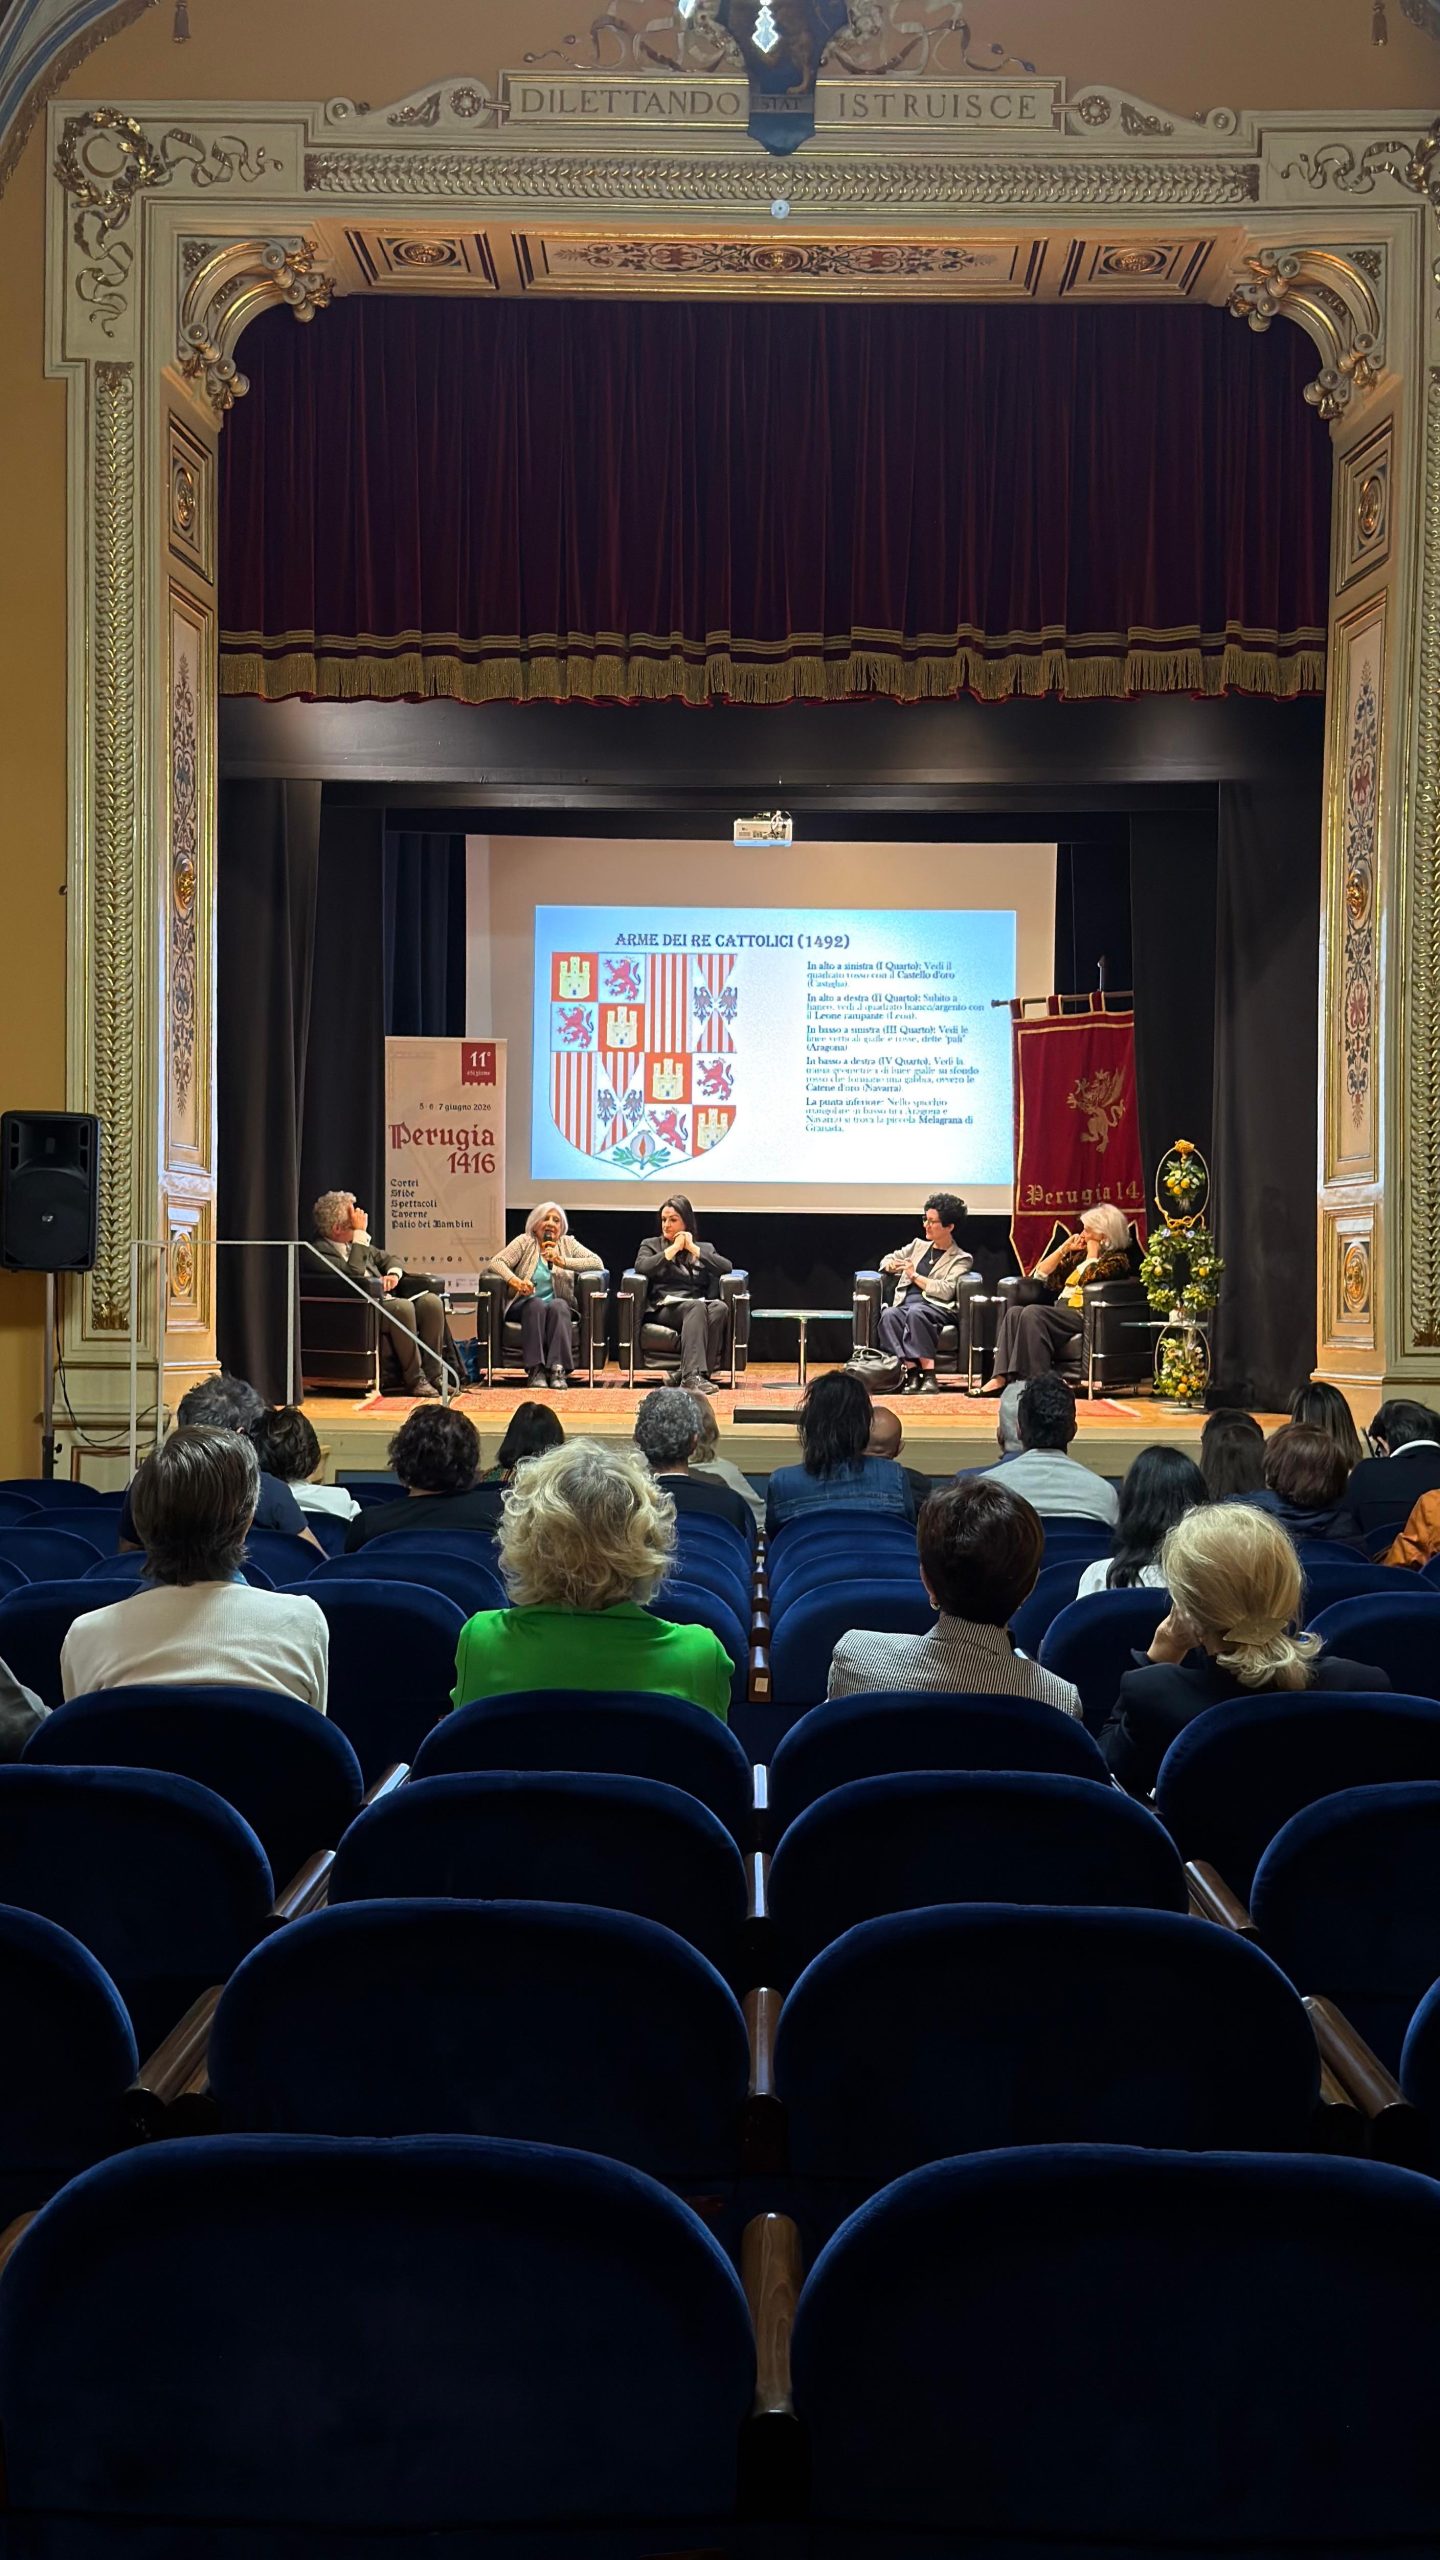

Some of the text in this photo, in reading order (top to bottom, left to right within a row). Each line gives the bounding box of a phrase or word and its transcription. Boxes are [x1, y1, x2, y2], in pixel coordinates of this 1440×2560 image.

[520, 88, 741, 116] DILETTANDO
[838, 93, 1037, 120] ISTRUISCE
[615, 933, 851, 949] ARME DEI RE CATTOLICI (1492)
[806, 961, 816, 971] In
[818, 961, 835, 971] alto
[844, 961, 874, 970] sinistra
[924, 961, 944, 970] Vedi
[897, 971, 931, 979] Castello
[807, 993, 816, 1002] In
[818, 993, 835, 1002] alto
[844, 994, 869, 1002] destra
[923, 994, 951, 1002] Subito
[806, 1025, 816, 1034] In
[817, 1025, 841, 1034] basso
[850, 1026, 880, 1034] sinistra
[939, 1025, 959, 1034] Vedi
[961, 1026, 969, 1034] le
[806, 1057, 815, 1065] In
[817, 1057, 842, 1065] basso
[850, 1057, 877, 1065] destra
[949, 1066, 980, 1075] sfondo
[805, 1083, 836, 1092] Catene
[806, 1097, 818, 1106] La
[819, 1099, 844, 1107] punta
[438, 1103, 444, 1111] 7
[444, 1103, 472, 1112] giugno
[919, 1115, 963, 1125] Melagrana
[964, 1115, 974, 1124] di
[389, 1121, 495, 1151] Perugia
[447, 1152, 496, 1174] 1416
[390, 1179, 419, 1188] Cortei
[390, 1189, 415, 1198] Sfide
[1025, 1180, 1145, 1206] Perugia 14
[390, 1199, 438, 1209] Spettacoli
[391, 1209, 428, 1218] Taverne
[392, 1220, 474, 1230] Palio dei Bambini
